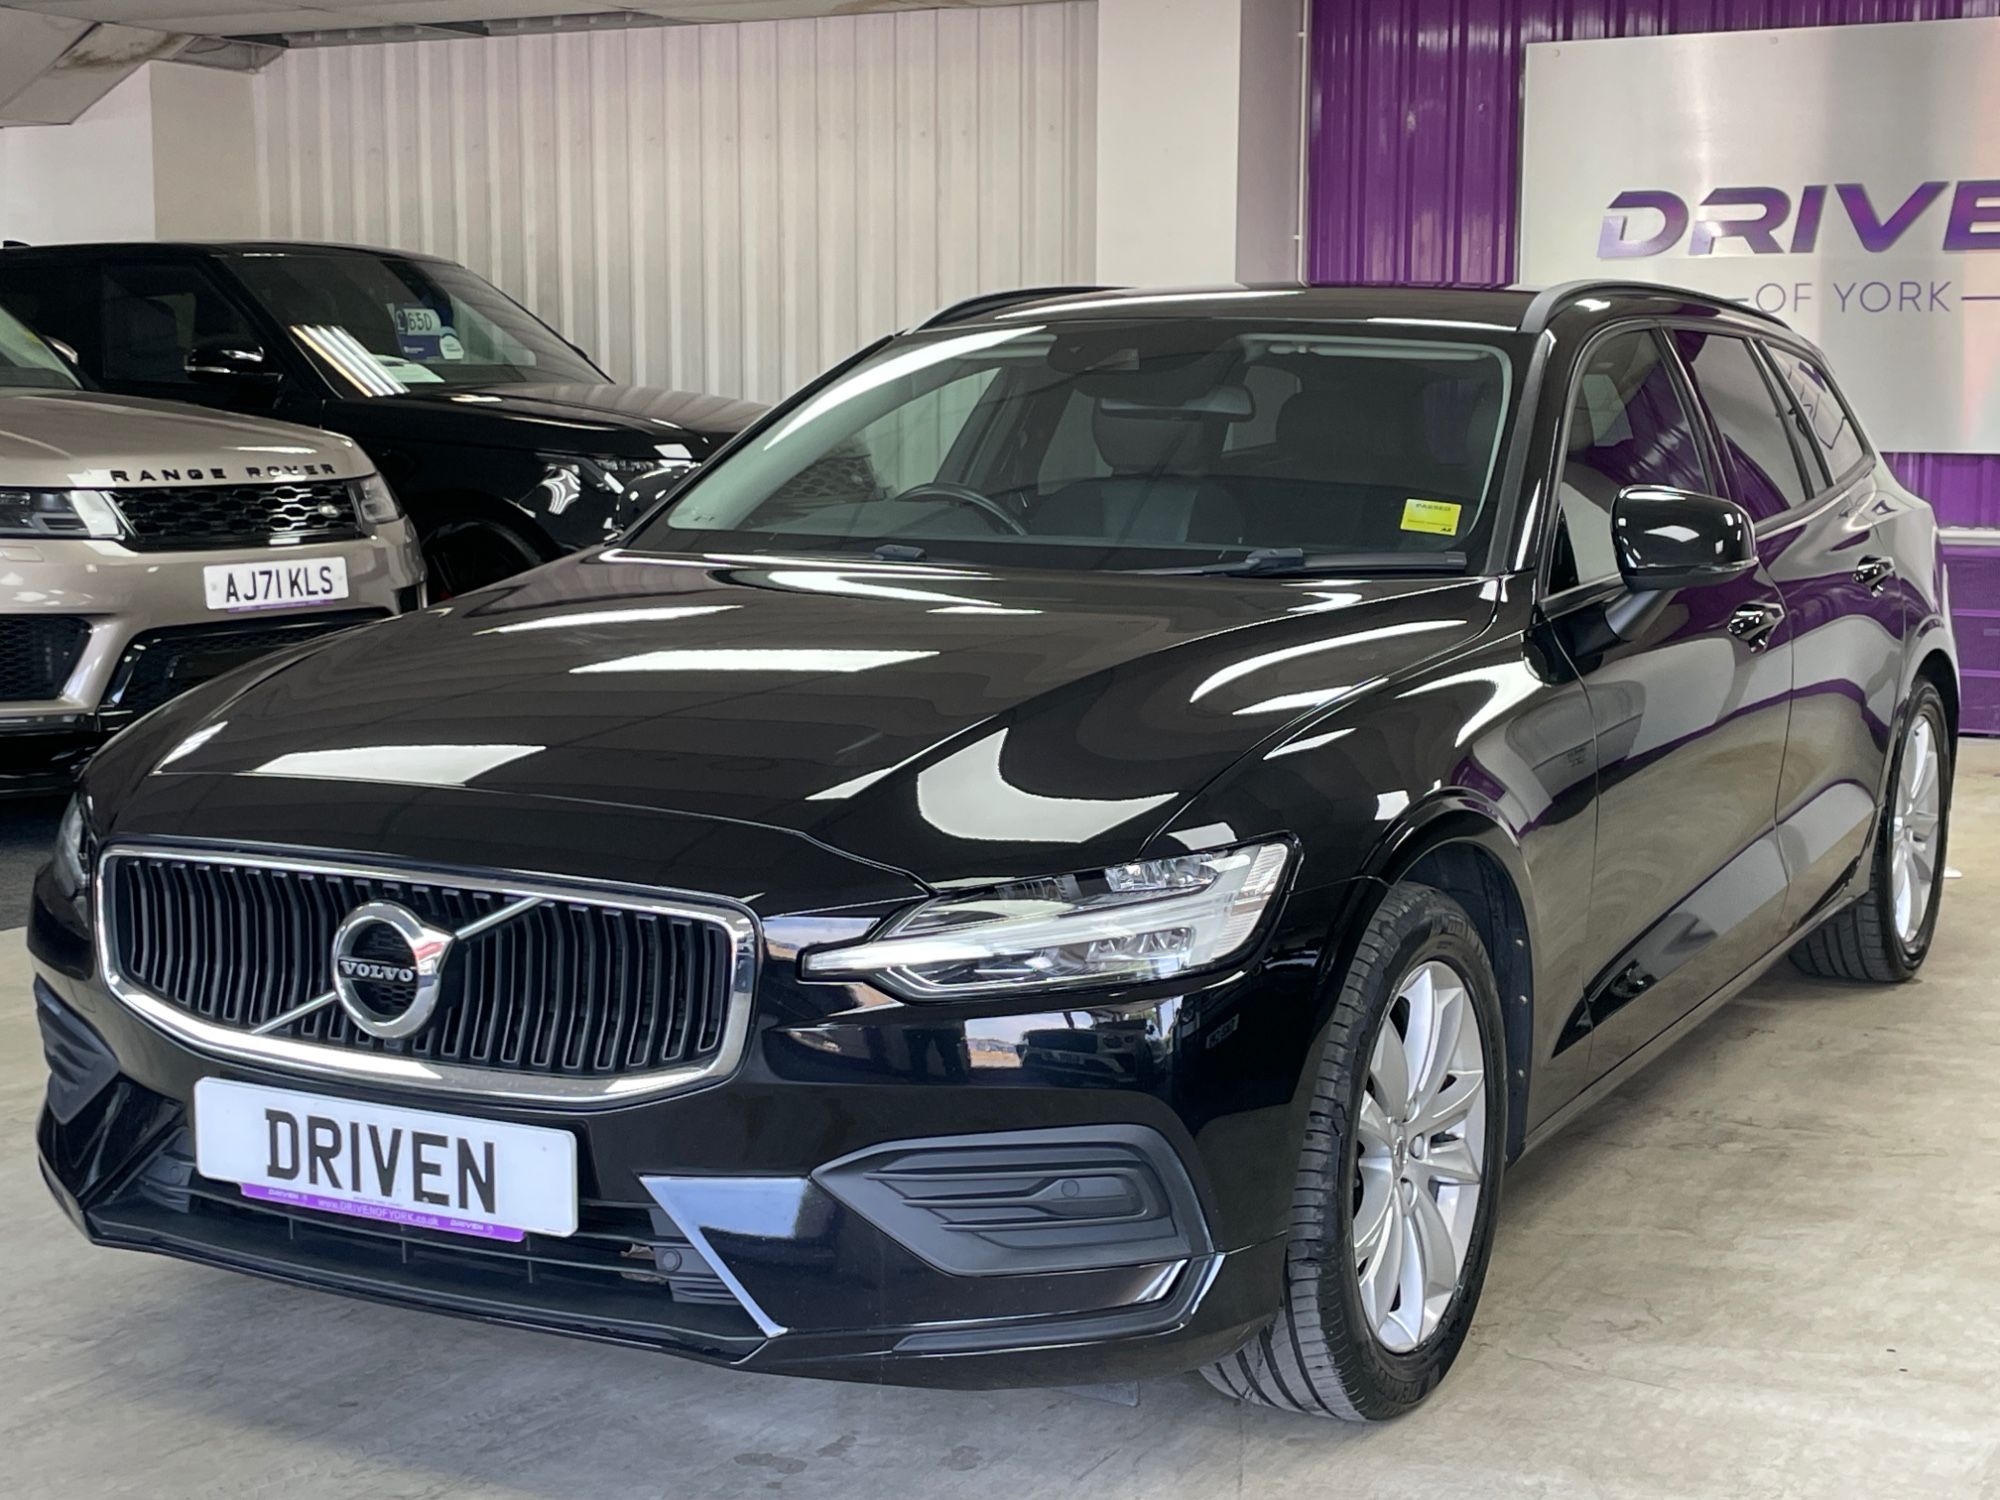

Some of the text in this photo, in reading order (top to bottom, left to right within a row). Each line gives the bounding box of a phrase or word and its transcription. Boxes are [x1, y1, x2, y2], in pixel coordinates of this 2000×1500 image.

[1756, 281, 1952, 314] OF YORK
[110, 463, 336, 482] RANGE ROVER
[340, 961, 414, 982] VOLVO
[265, 1108, 496, 1214] DRIVEN
